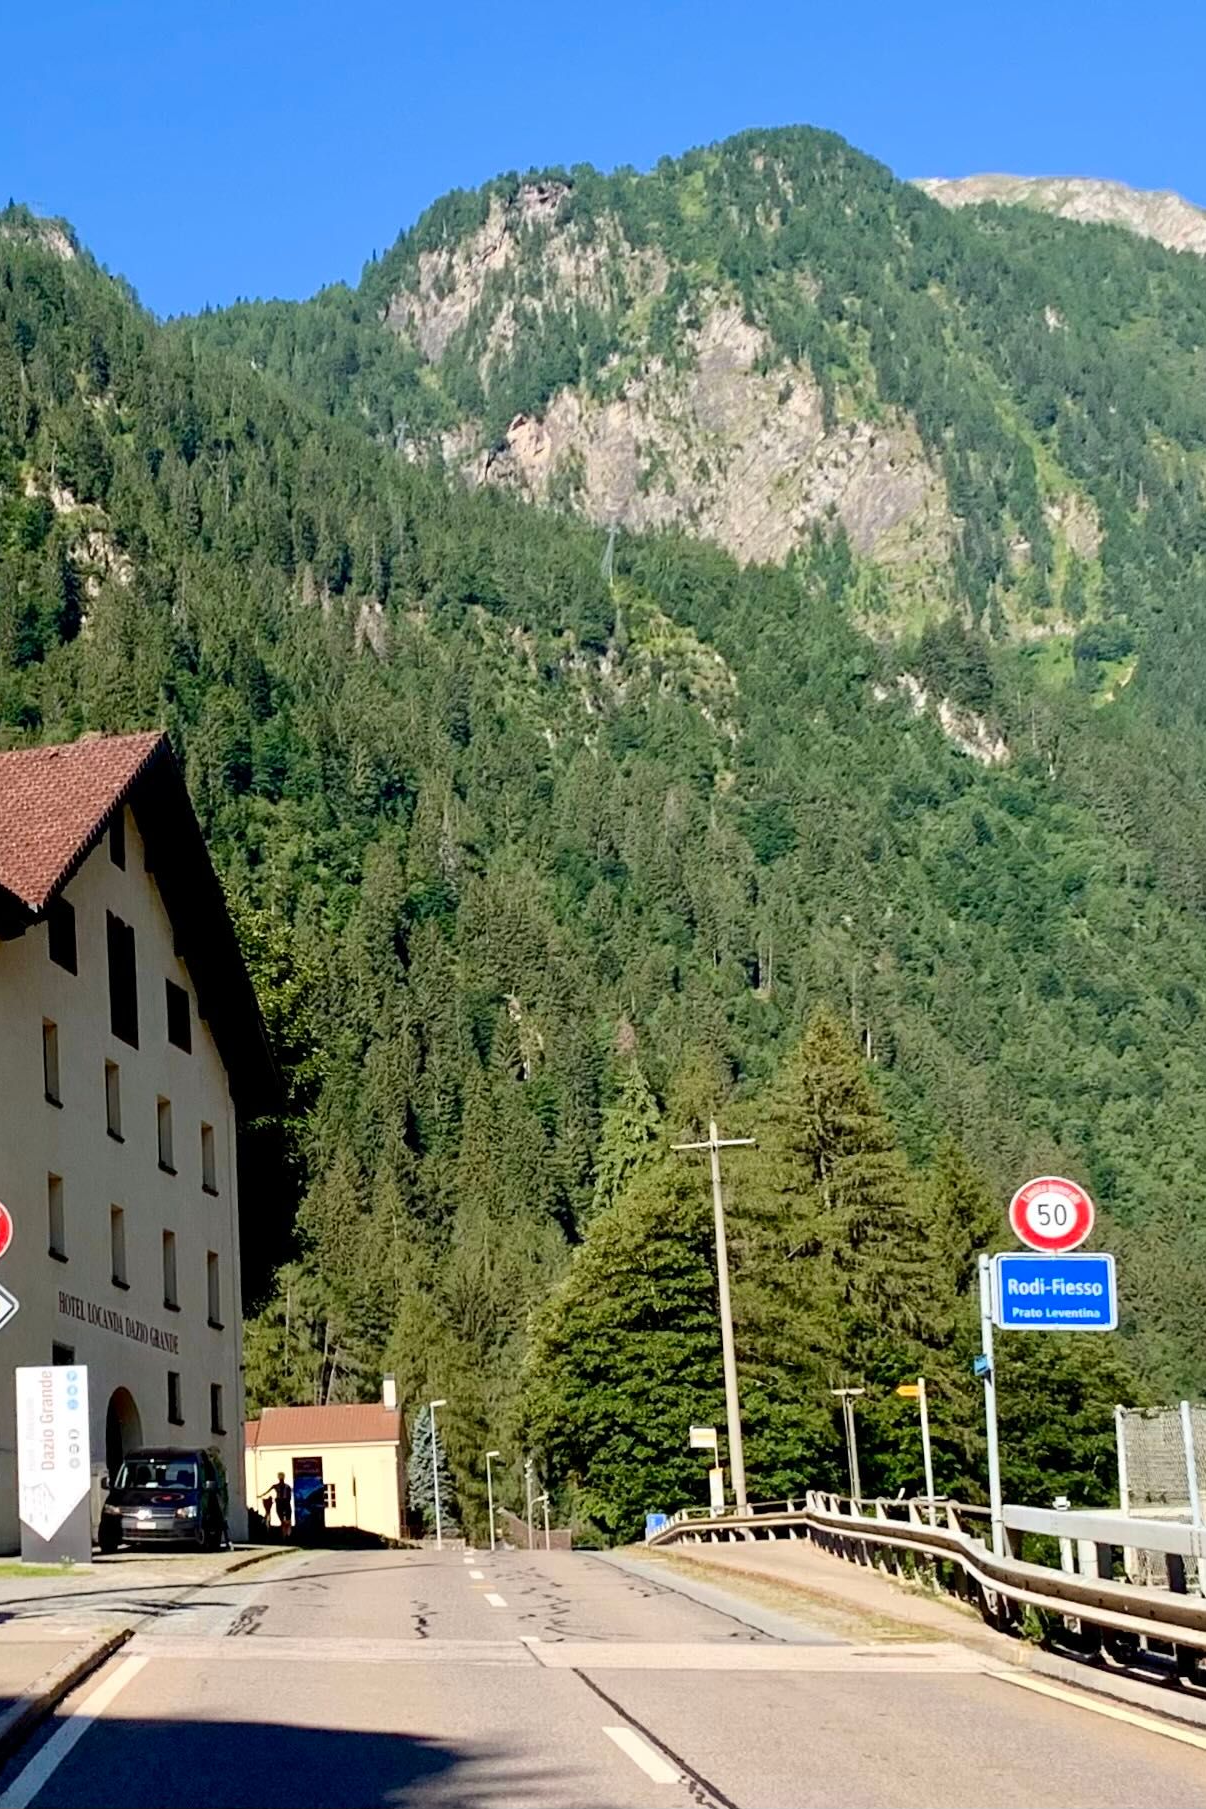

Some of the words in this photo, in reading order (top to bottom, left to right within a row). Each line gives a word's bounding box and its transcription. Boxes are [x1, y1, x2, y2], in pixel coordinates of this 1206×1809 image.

[1038, 1204, 1067, 1225] 50
[1008, 1278, 1103, 1296] Rodi-Fiesso
[58, 1291, 86, 1321] HOTEL
[88, 1302, 124, 1336] LOCANDA
[125, 1316, 149, 1345] DAZIO
[150, 1326, 180, 1355] GRANDE
[1012, 1307, 1042, 1318] Prato
[1046, 1307, 1101, 1319] Leventina
[38, 1370, 54, 1424] Grande
[40, 1429, 56, 1470] Dazio
